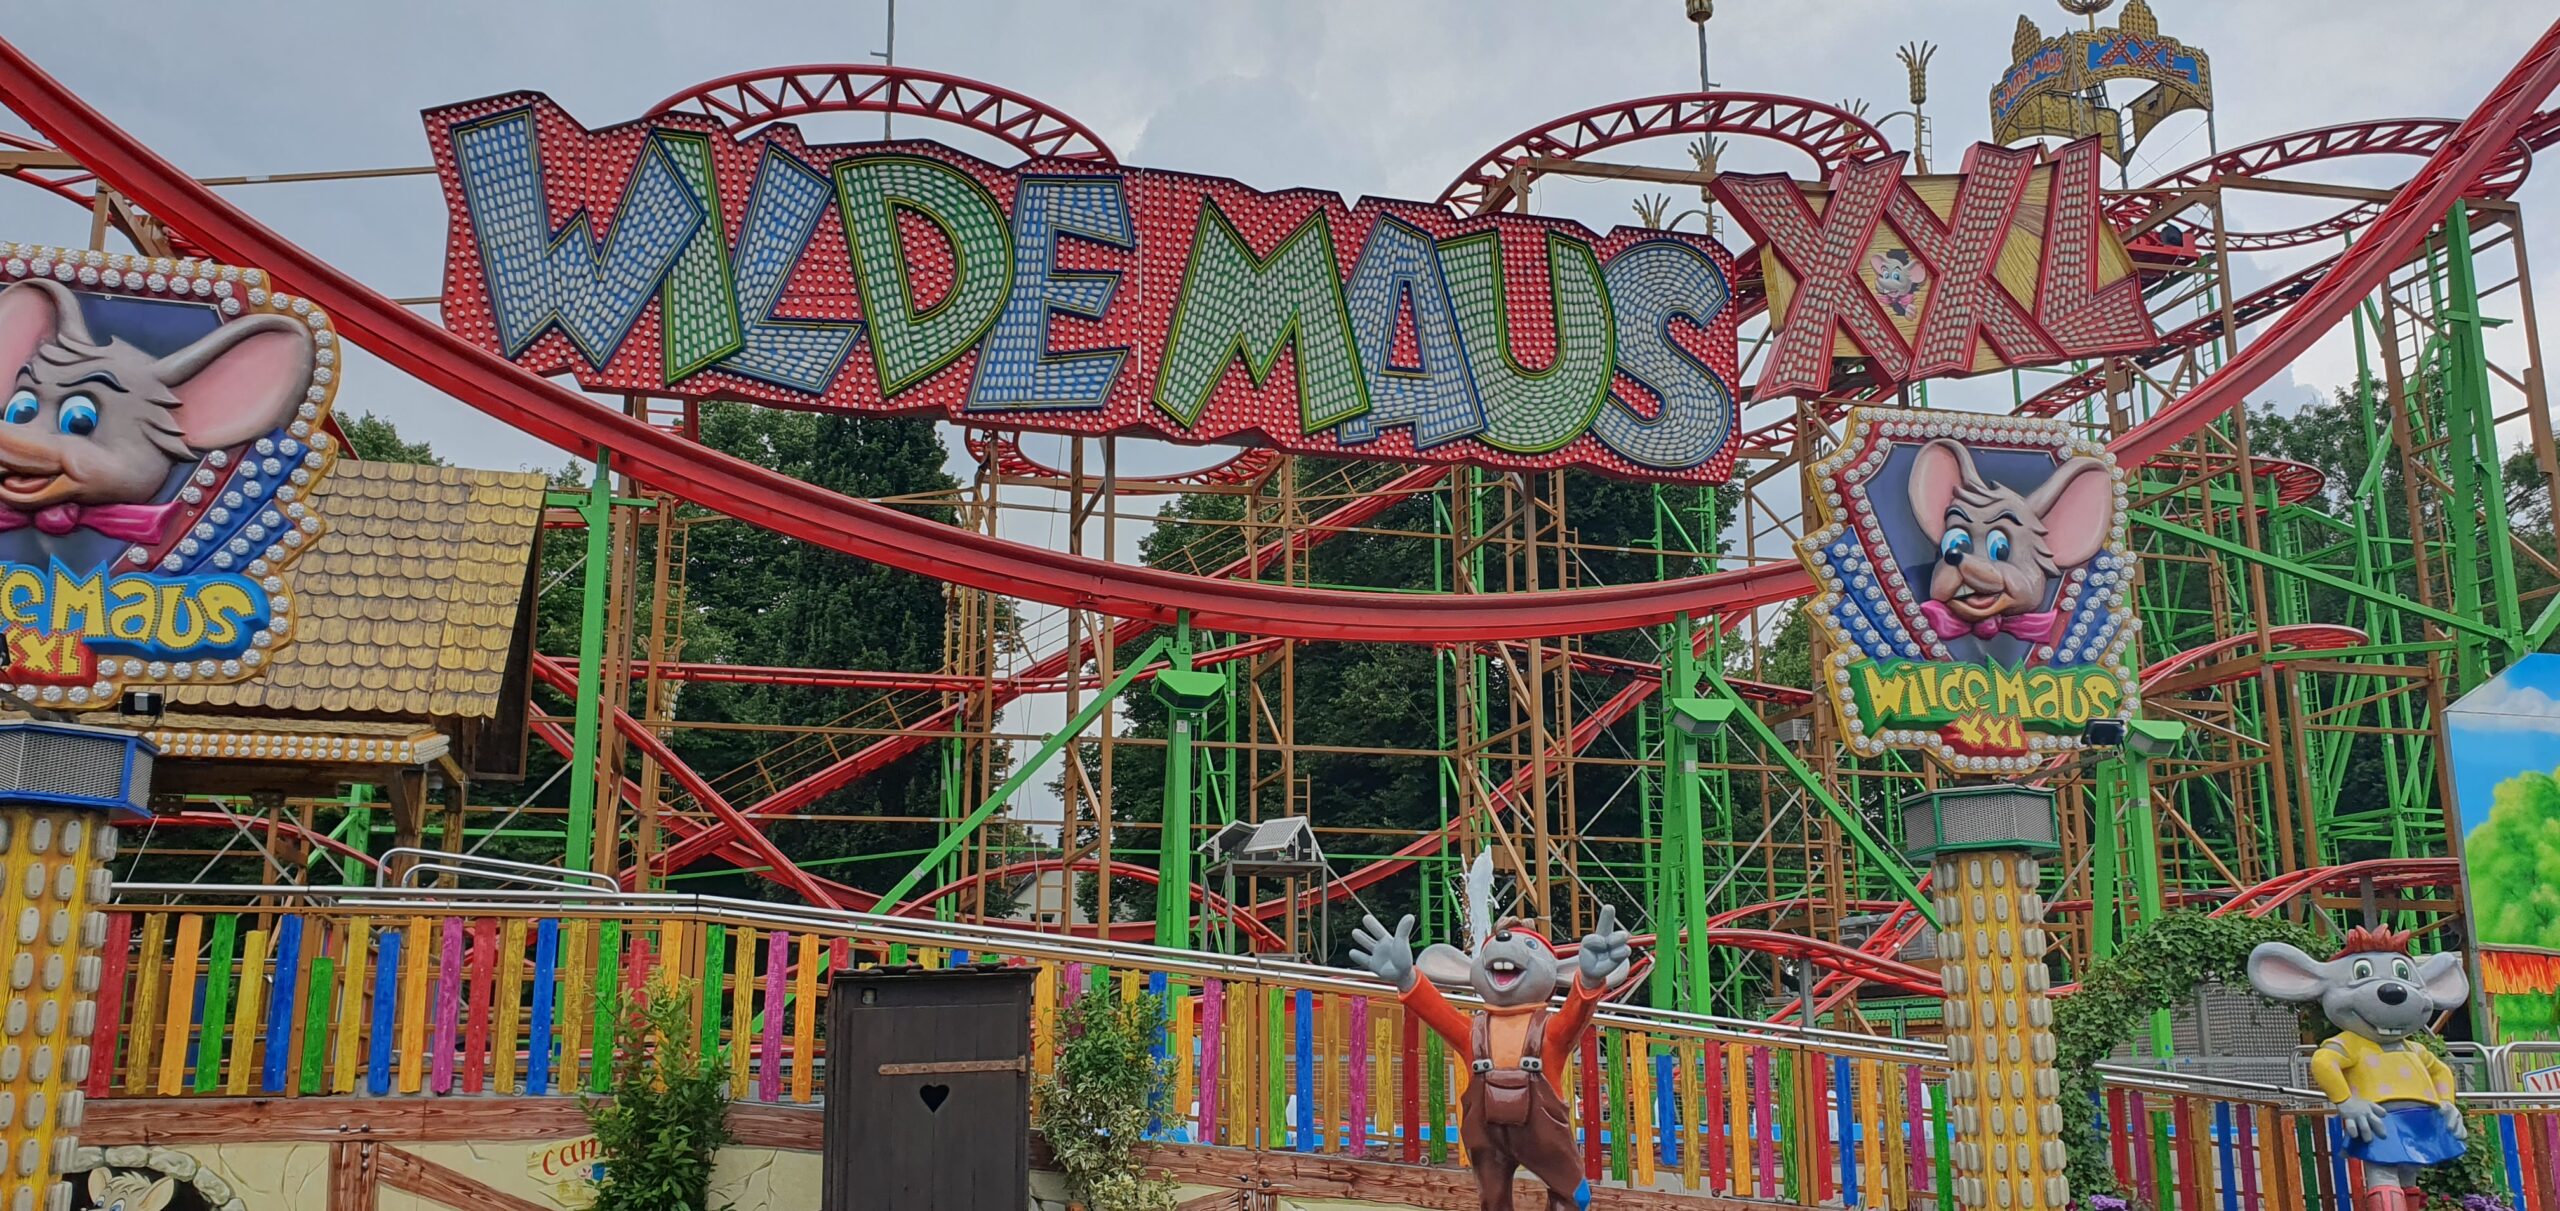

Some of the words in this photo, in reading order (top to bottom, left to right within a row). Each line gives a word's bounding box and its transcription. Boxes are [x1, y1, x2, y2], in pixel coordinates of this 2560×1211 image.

[1996, 64, 2031, 111] WILDE
[2030, 51, 2064, 81] MAUS
[2097, 31, 2191, 79] XXL
[450, 104, 1136, 413] WILDE
[1153, 194, 1735, 470] MAUS
[1708, 132, 2161, 406] XXL
[1863, 664, 1990, 720] Wilde
[1955, 711, 2023, 750] XXL
